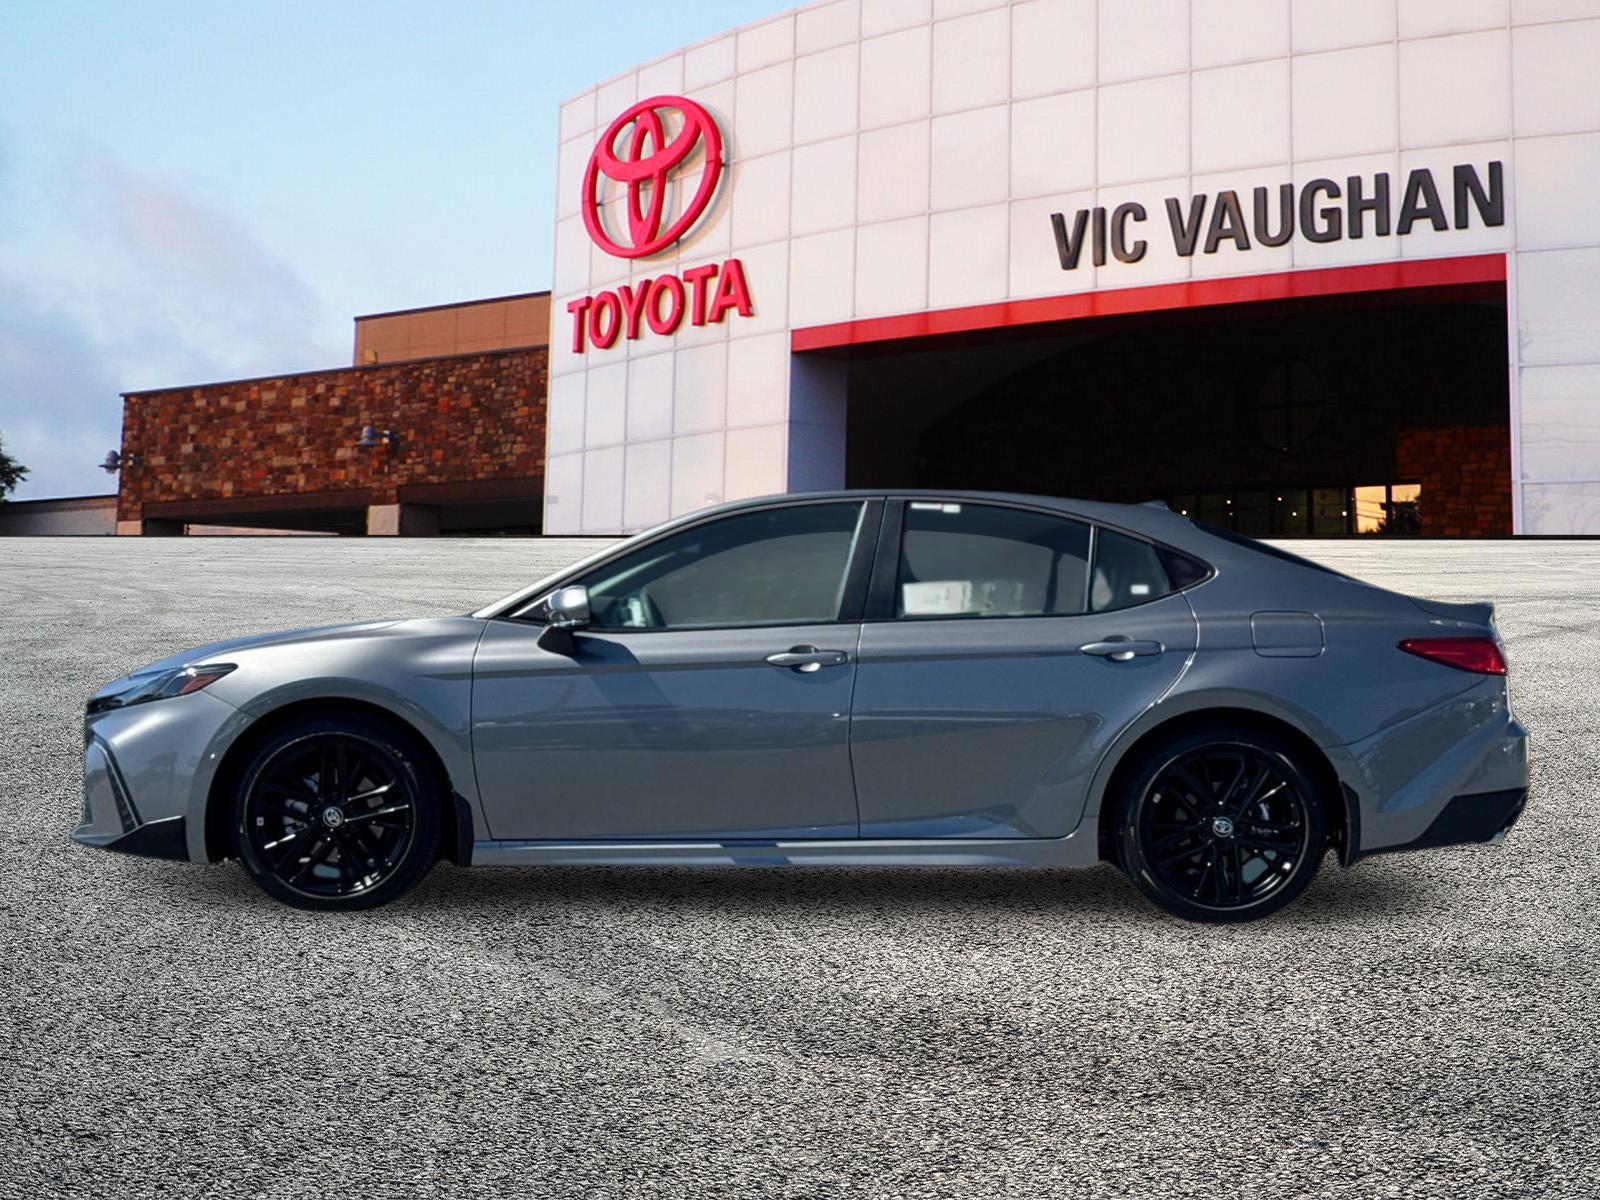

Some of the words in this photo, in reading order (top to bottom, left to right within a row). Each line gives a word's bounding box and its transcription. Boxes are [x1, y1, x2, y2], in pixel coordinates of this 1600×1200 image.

[1050, 201, 1148, 270] VIC
[1165, 160, 1505, 257] VAUGHAN
[567, 258, 754, 354] TOYOTA
